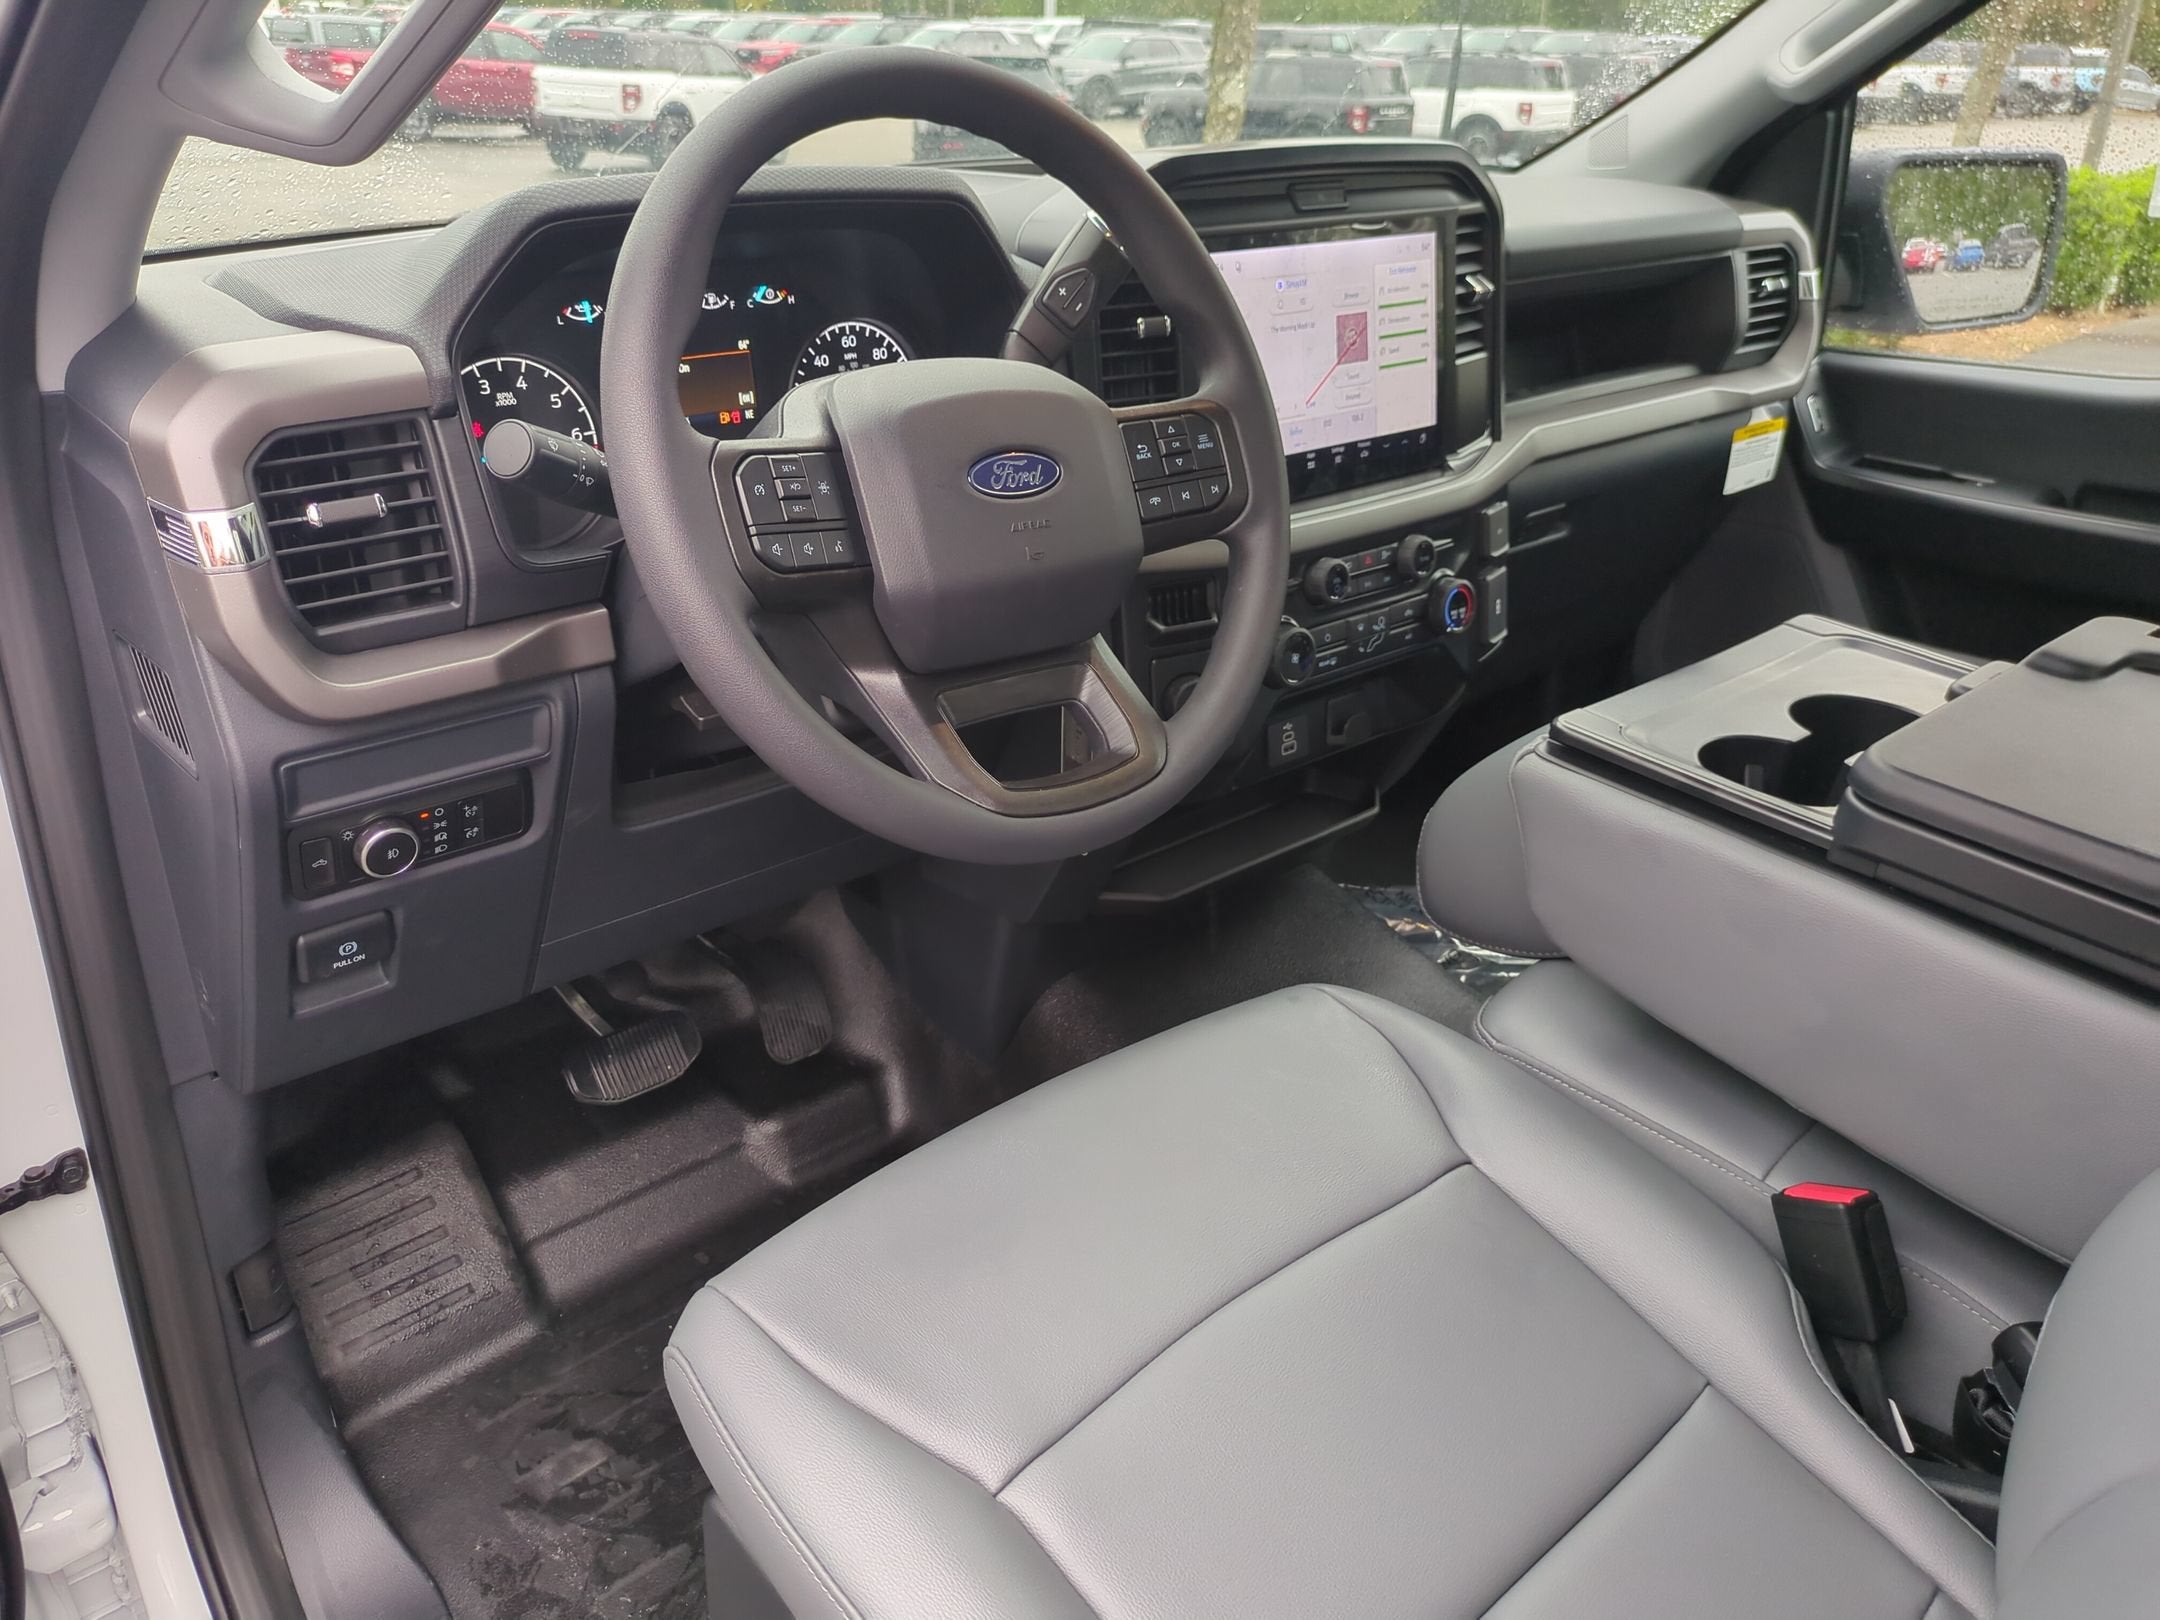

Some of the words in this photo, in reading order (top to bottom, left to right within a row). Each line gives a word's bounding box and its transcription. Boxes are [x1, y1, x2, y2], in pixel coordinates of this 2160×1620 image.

[730, 300, 736, 310] F
[788, 295, 796, 305] H
[556, 315, 564, 325] L
[841, 335, 857, 348] 60
[813, 354, 830, 368] 40
[844, 352, 857, 361] MPH
[872, 348, 888, 361] 80
[478, 379, 491, 395] 3
[516, 375, 528, 390] 4
[496, 391, 514, 401] RPM
[550, 393, 562, 409] 5
[744, 409, 755, 420] NE
[571, 427, 583, 441] 6
[1197, 441, 1214, 450] MENU
[1136, 452, 1152, 460] BACK
[990, 459, 1044, 490] Ford
[333, 958, 353, 969] PULL
[353, 953, 366, 963] ON
